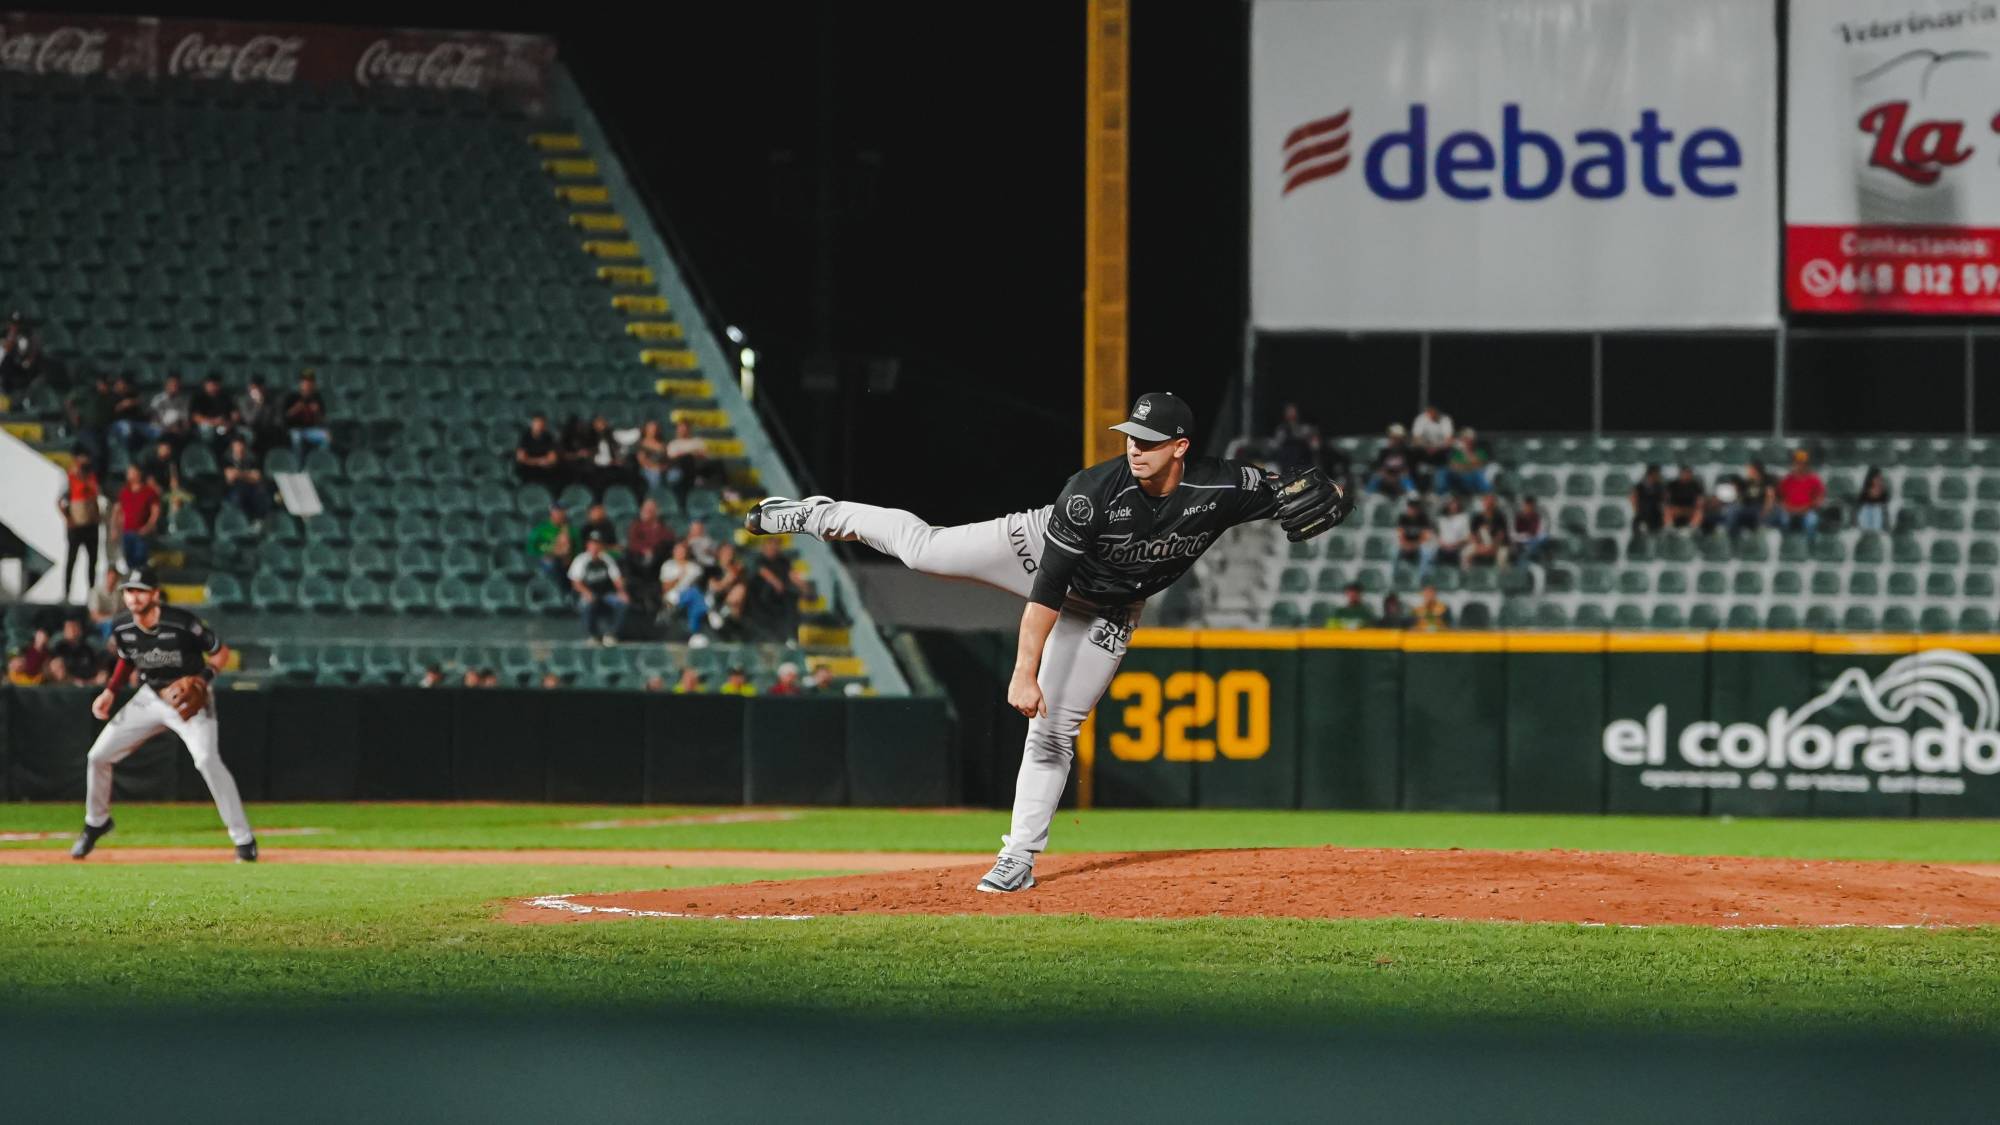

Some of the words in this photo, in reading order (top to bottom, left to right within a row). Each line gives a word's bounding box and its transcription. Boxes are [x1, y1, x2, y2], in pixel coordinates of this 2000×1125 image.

[1363, 103, 1743, 201] debate
[1857, 100, 1975, 187] La
[1097, 532, 1209, 564] Tomatero
[1109, 669, 1271, 762] 320
[1602, 703, 1668, 767] el
[1678, 706, 2000, 775] colorado
